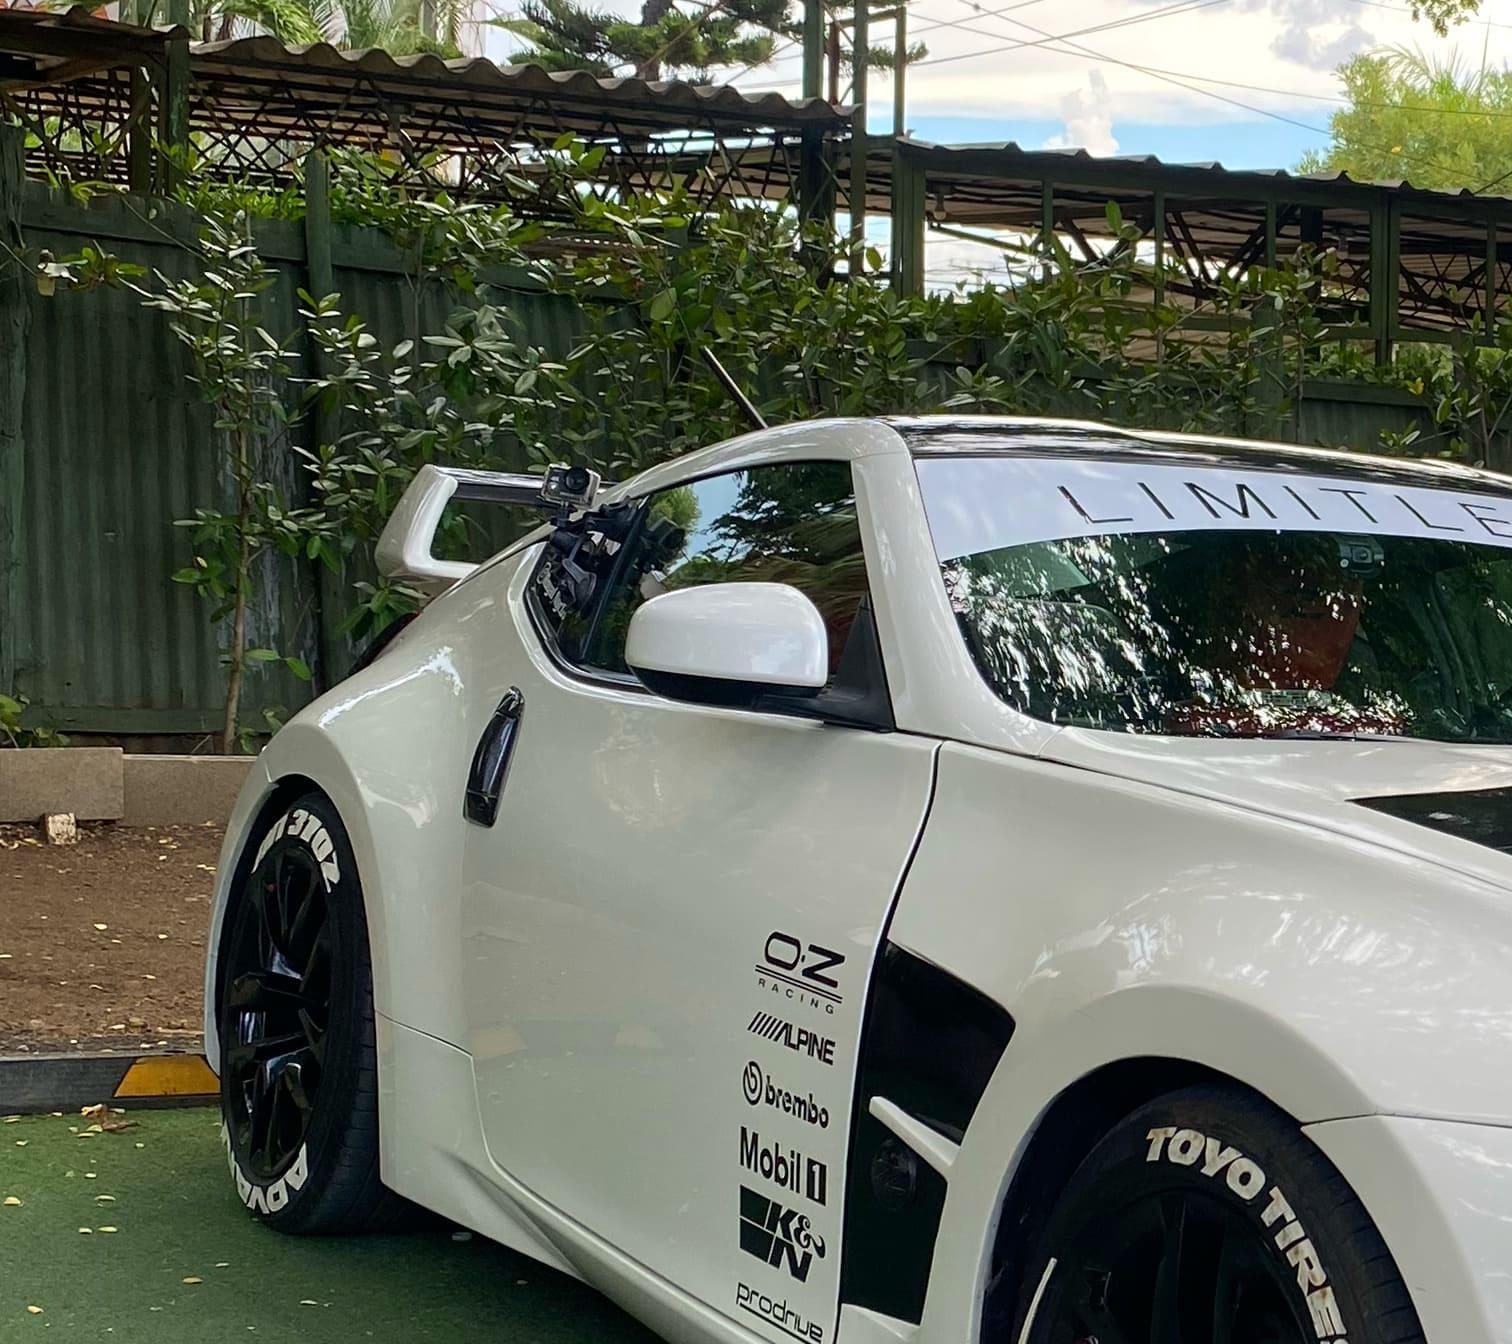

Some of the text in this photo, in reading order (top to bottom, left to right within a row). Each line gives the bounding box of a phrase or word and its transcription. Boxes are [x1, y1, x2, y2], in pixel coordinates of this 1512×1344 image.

[757, 977, 835, 1015] RACING
[764, 1074, 829, 1130] brembo
[739, 1126, 825, 1205] Mobil 1
[1145, 1125, 1265, 1201] TOYO
[736, 1281, 823, 1343] prodrive
